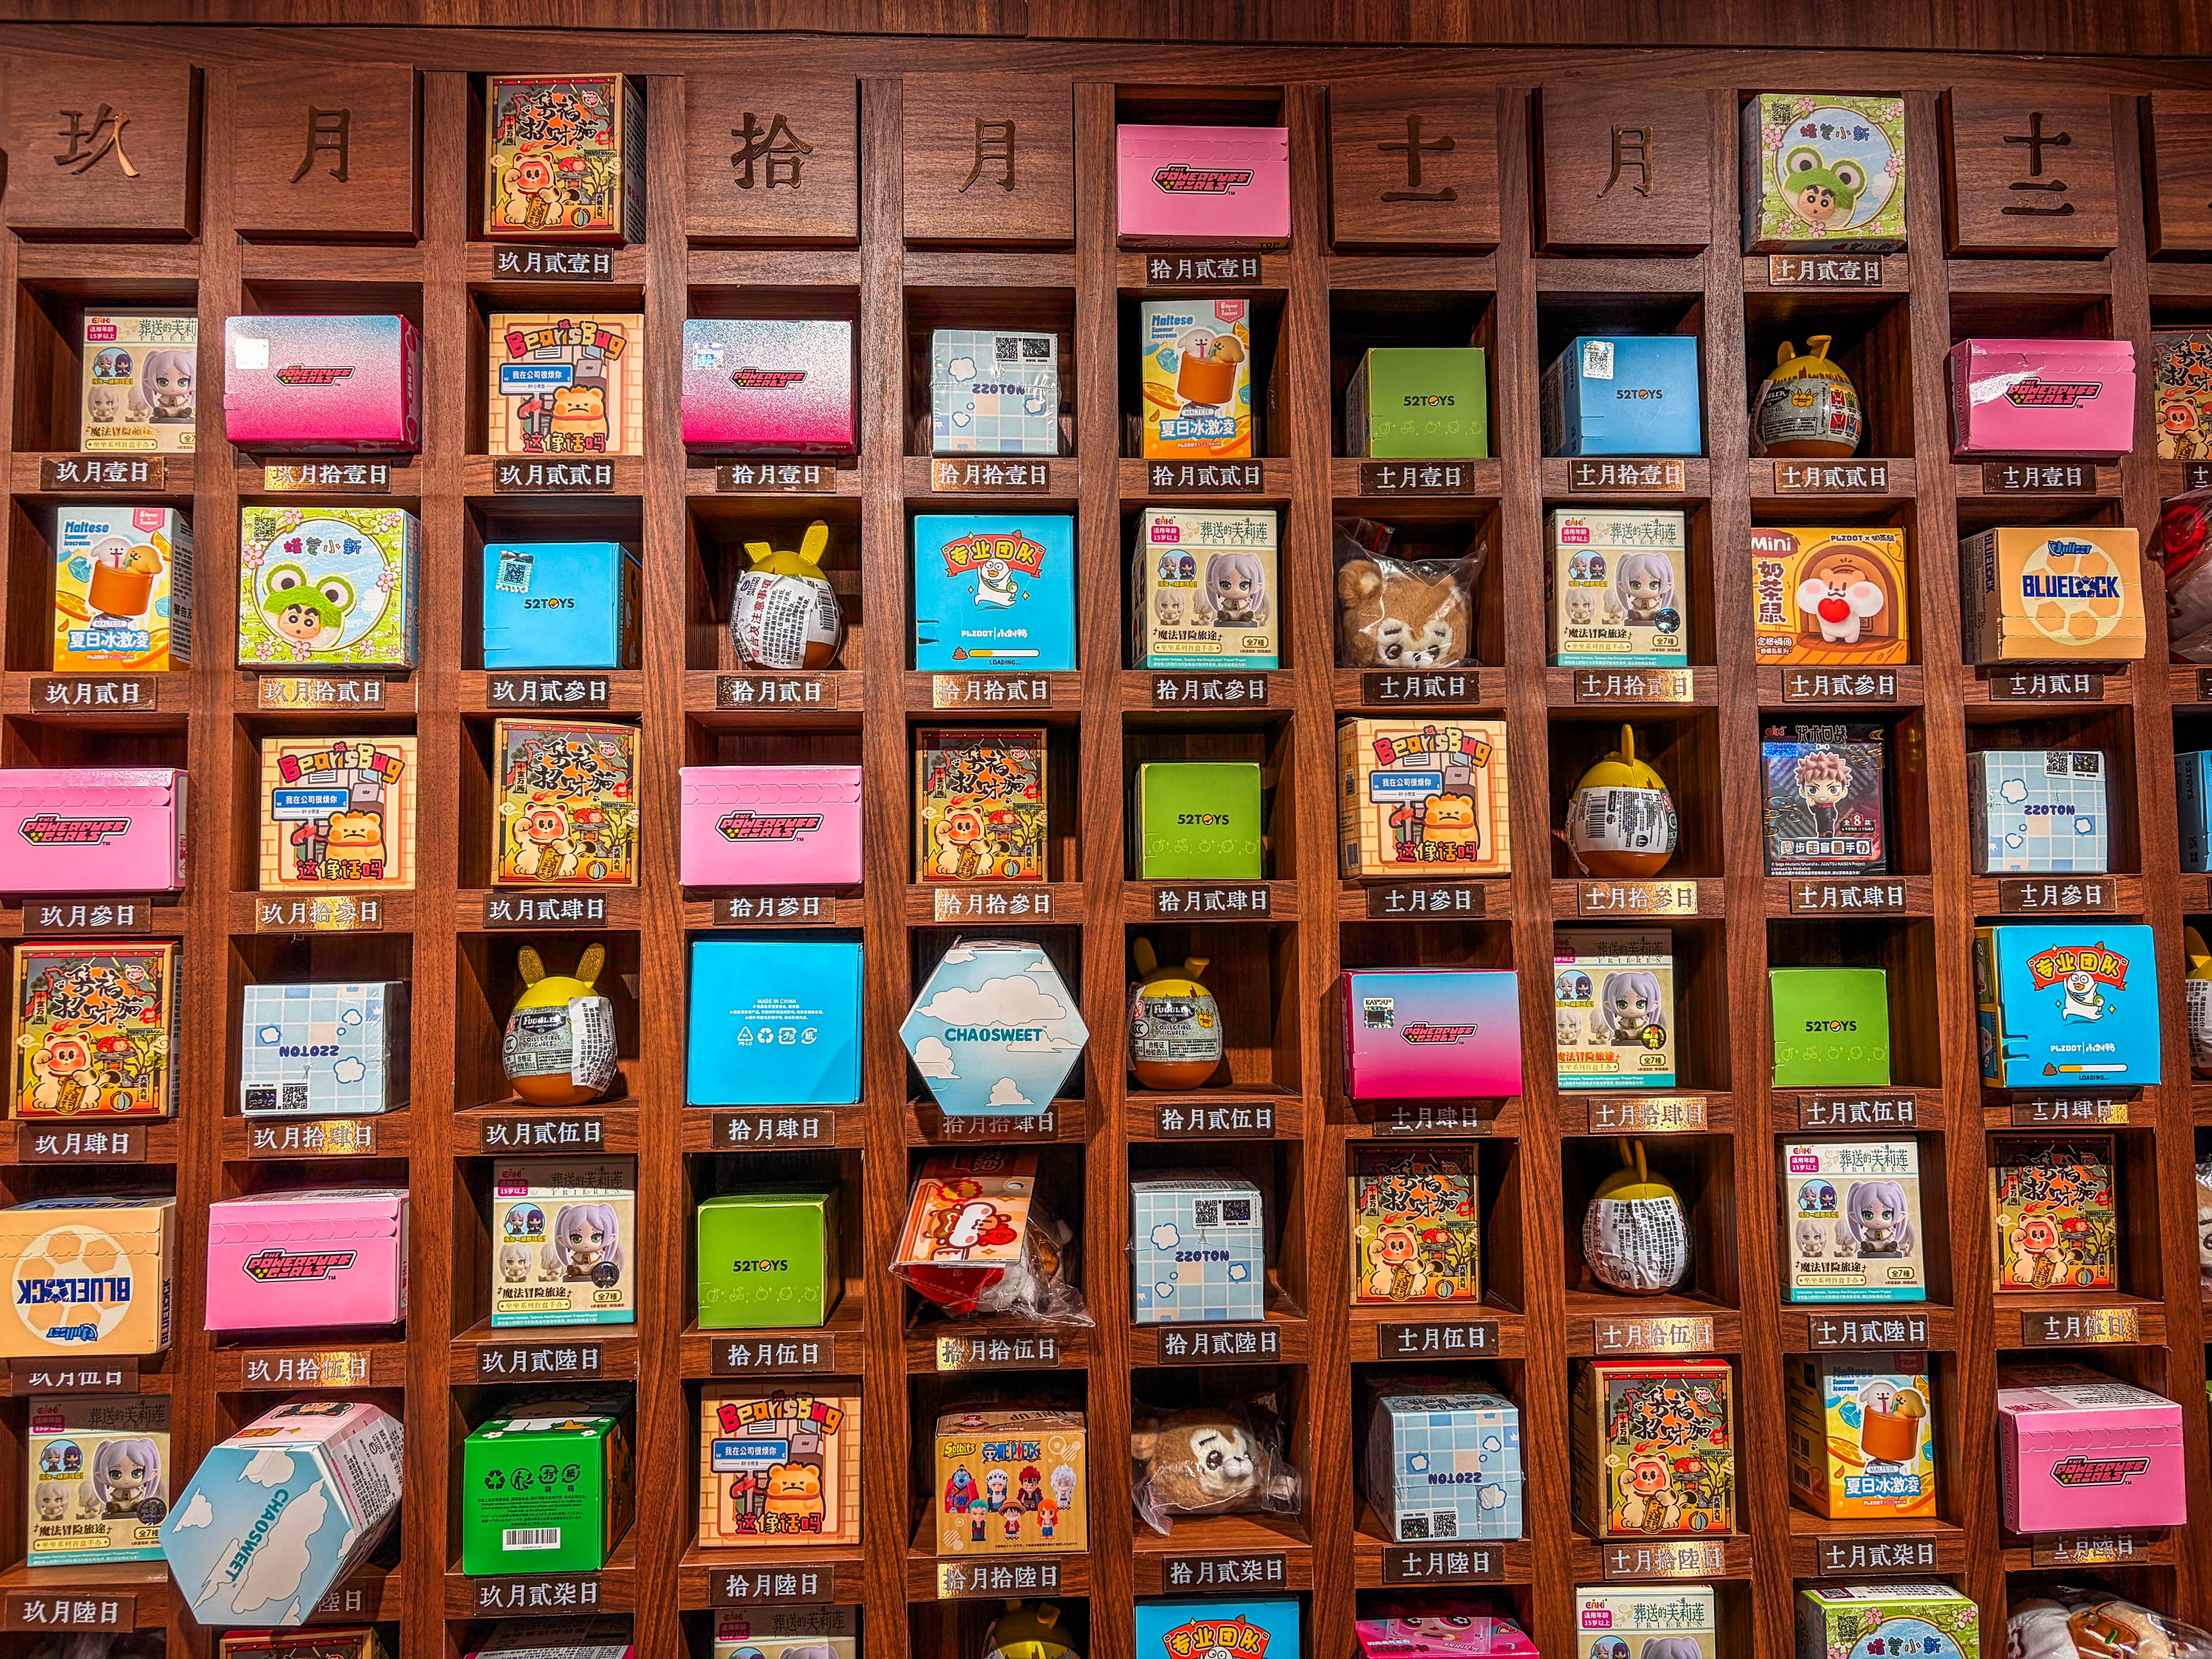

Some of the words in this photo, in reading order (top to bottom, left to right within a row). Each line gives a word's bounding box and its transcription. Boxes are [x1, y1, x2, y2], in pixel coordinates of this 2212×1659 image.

[54, 103, 139, 177] 玖
[289, 105, 350, 183] 月
[731, 112, 813, 189] 拾
[959, 116, 1015, 193] 月
[1597, 125, 1653, 197] 月
[1152, 315, 1192, 325] Maltese
[512, 370, 562, 380] 我在公司很烦你
[1404, 395, 1455, 407] 52TOYS
[1616, 389, 1662, 400] 52TOYS
[1161, 421, 1235, 437] 夏日冰激凌
[523, 433, 606, 453] 这像话吗
[65, 521, 109, 533] Maltese
[1200, 519, 1267, 540] 葬送的芙莉莲
[1610, 521, 1676, 540] 葬送的芙莉莲
[1751, 536, 1791, 552] Mini
[950, 540, 1038, 566] 专业团队
[525, 598, 574, 609] 52TOYS
[70, 631, 149, 648] 夏日冰激凌
[1382, 778, 1431, 787] 我在公司很烦你
[286, 796, 337, 804] 我在公司很烦你
[1177, 814, 1229, 825] 52TOYS
[1396, 842, 1476, 862] 这像话吗
[297, 859, 382, 880] 这像话吗
[2036, 952, 2120, 978] 专业团队
[1805, 1021, 1856, 1032] 52TOYS
[945, 1028, 1043, 1042] CHAOSWEET
[1840, 1149, 1908, 1167] 葬送的芙莉莲
[733, 1260, 787, 1271] 52TOYS
[733, 1260, 787, 1272] 52TOYS
[725, 1446, 777, 1456] 我在公司很烦你
[1846, 1476, 1921, 1495] 夏日冰激凌
[736, 1513, 821, 1535] 这像话吗
[227, 1488, 289, 1583] CHAOSWEET
[1634, 1603, 1705, 1623] 葬送的芙莉莲
